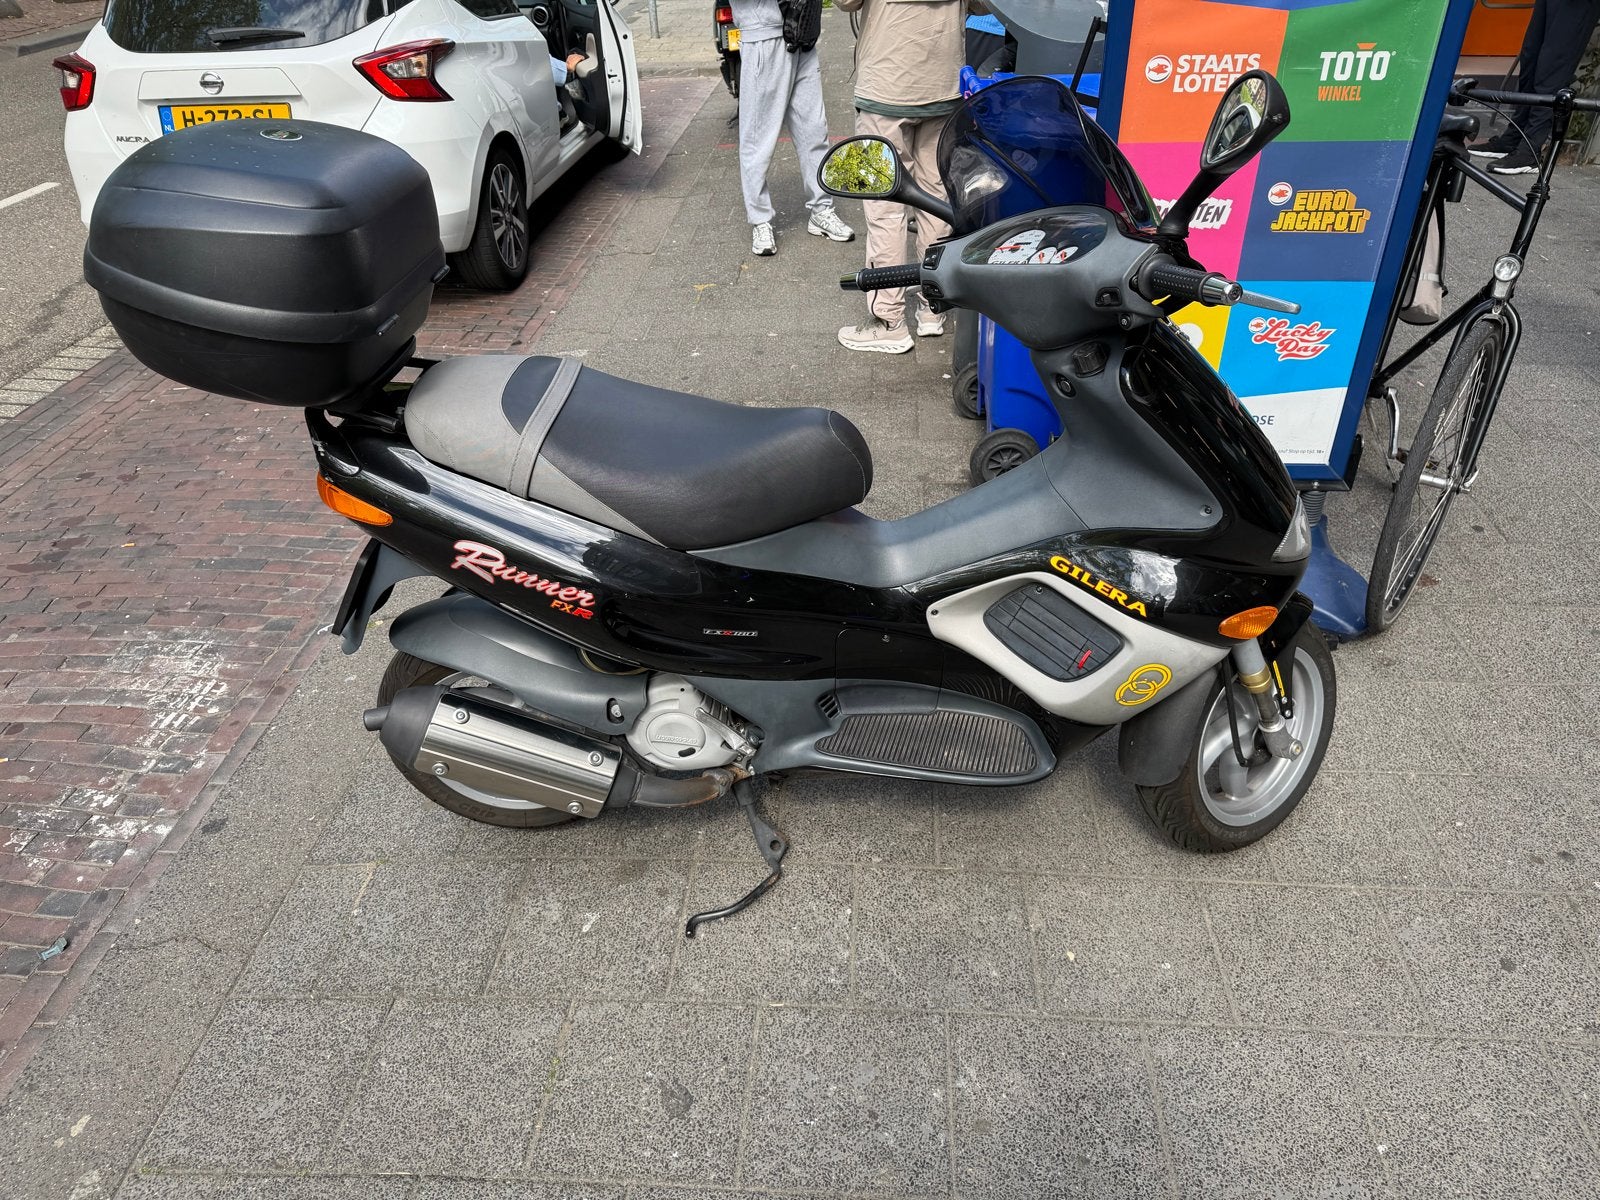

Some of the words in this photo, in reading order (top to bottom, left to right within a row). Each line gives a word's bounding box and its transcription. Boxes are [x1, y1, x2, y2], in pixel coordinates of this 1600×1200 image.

[1176, 53, 1261, 73] STAATS
[1319, 50, 1391, 81] TOTO
[1317, 85, 1362, 102] WINKEL
[116, 135, 152, 144] MICRA
[1293, 190, 1352, 211] EURO
[1270, 211, 1366, 232] JACKPOT
[1253, 318, 1335, 343] Lucky
[1276, 338, 1327, 360] Day
[450, 539, 596, 607] Runner
[1050, 554, 1147, 618] GILERA
[551, 599, 594, 620] FXR
